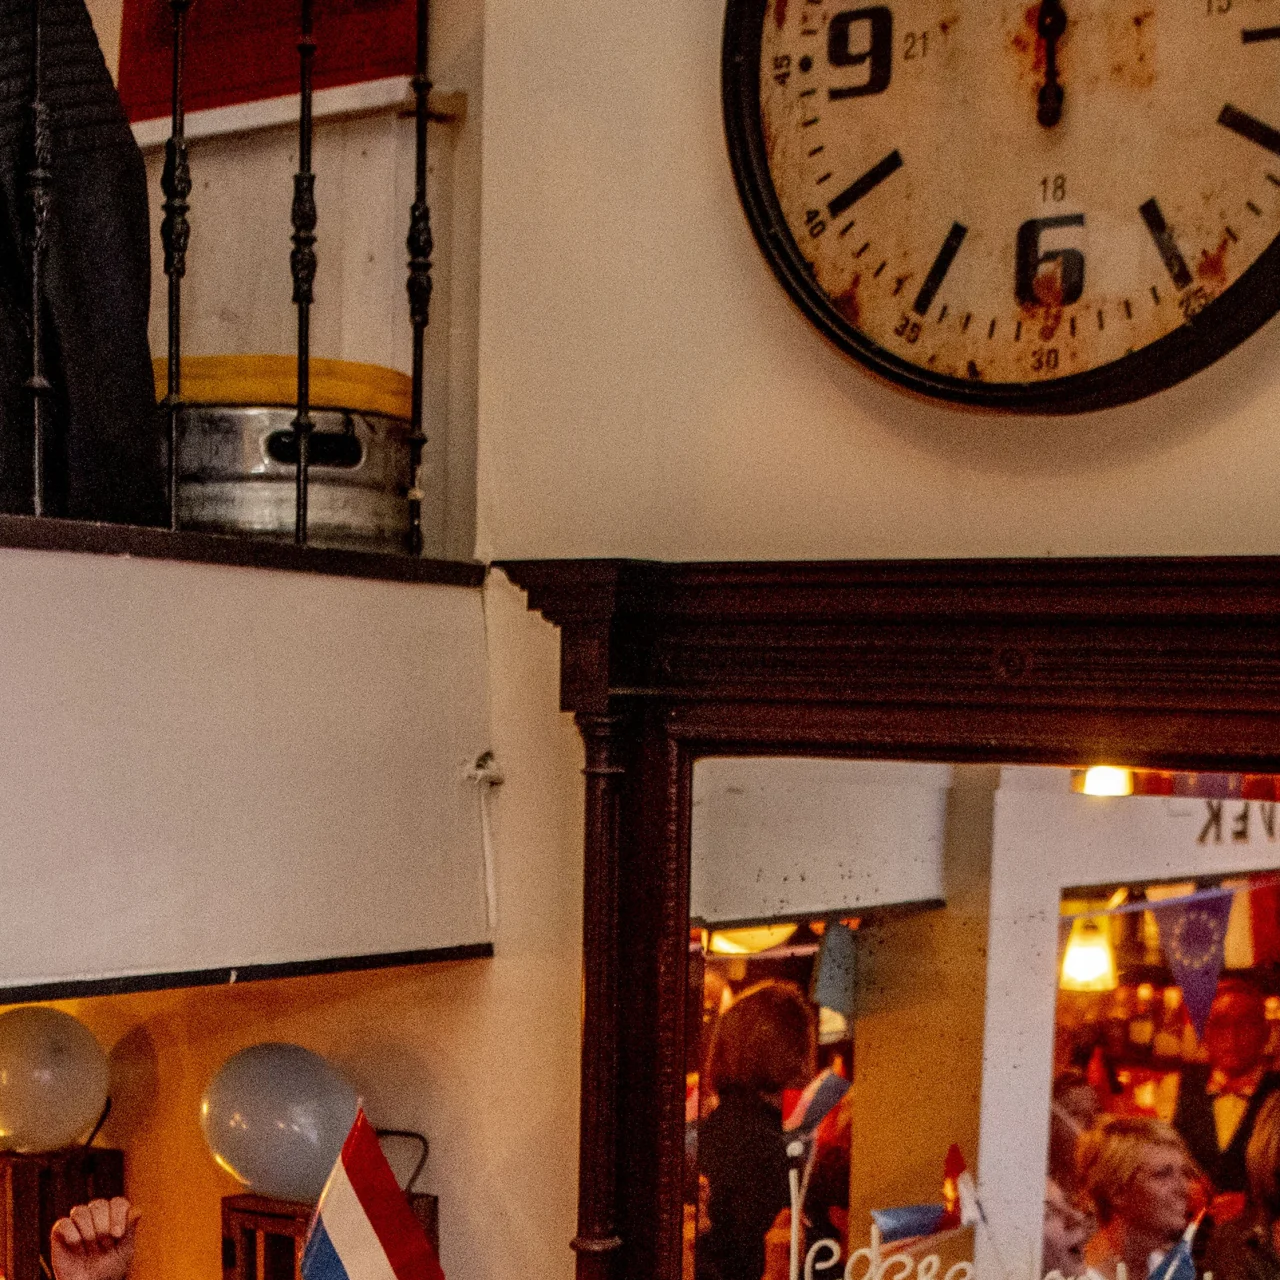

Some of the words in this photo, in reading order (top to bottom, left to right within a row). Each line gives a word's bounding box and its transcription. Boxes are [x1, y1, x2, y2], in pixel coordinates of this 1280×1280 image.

[827, 6, 892, 99] 9
[903, 31, 929, 60] 21
[773, 54, 791, 86] 45
[1040, 173, 1067, 202] 18
[805, 208, 827, 239] 40
[1015, 212, 1084, 306] 6
[894, 314, 922, 344] 35
[1031, 349, 1059, 371] 30
